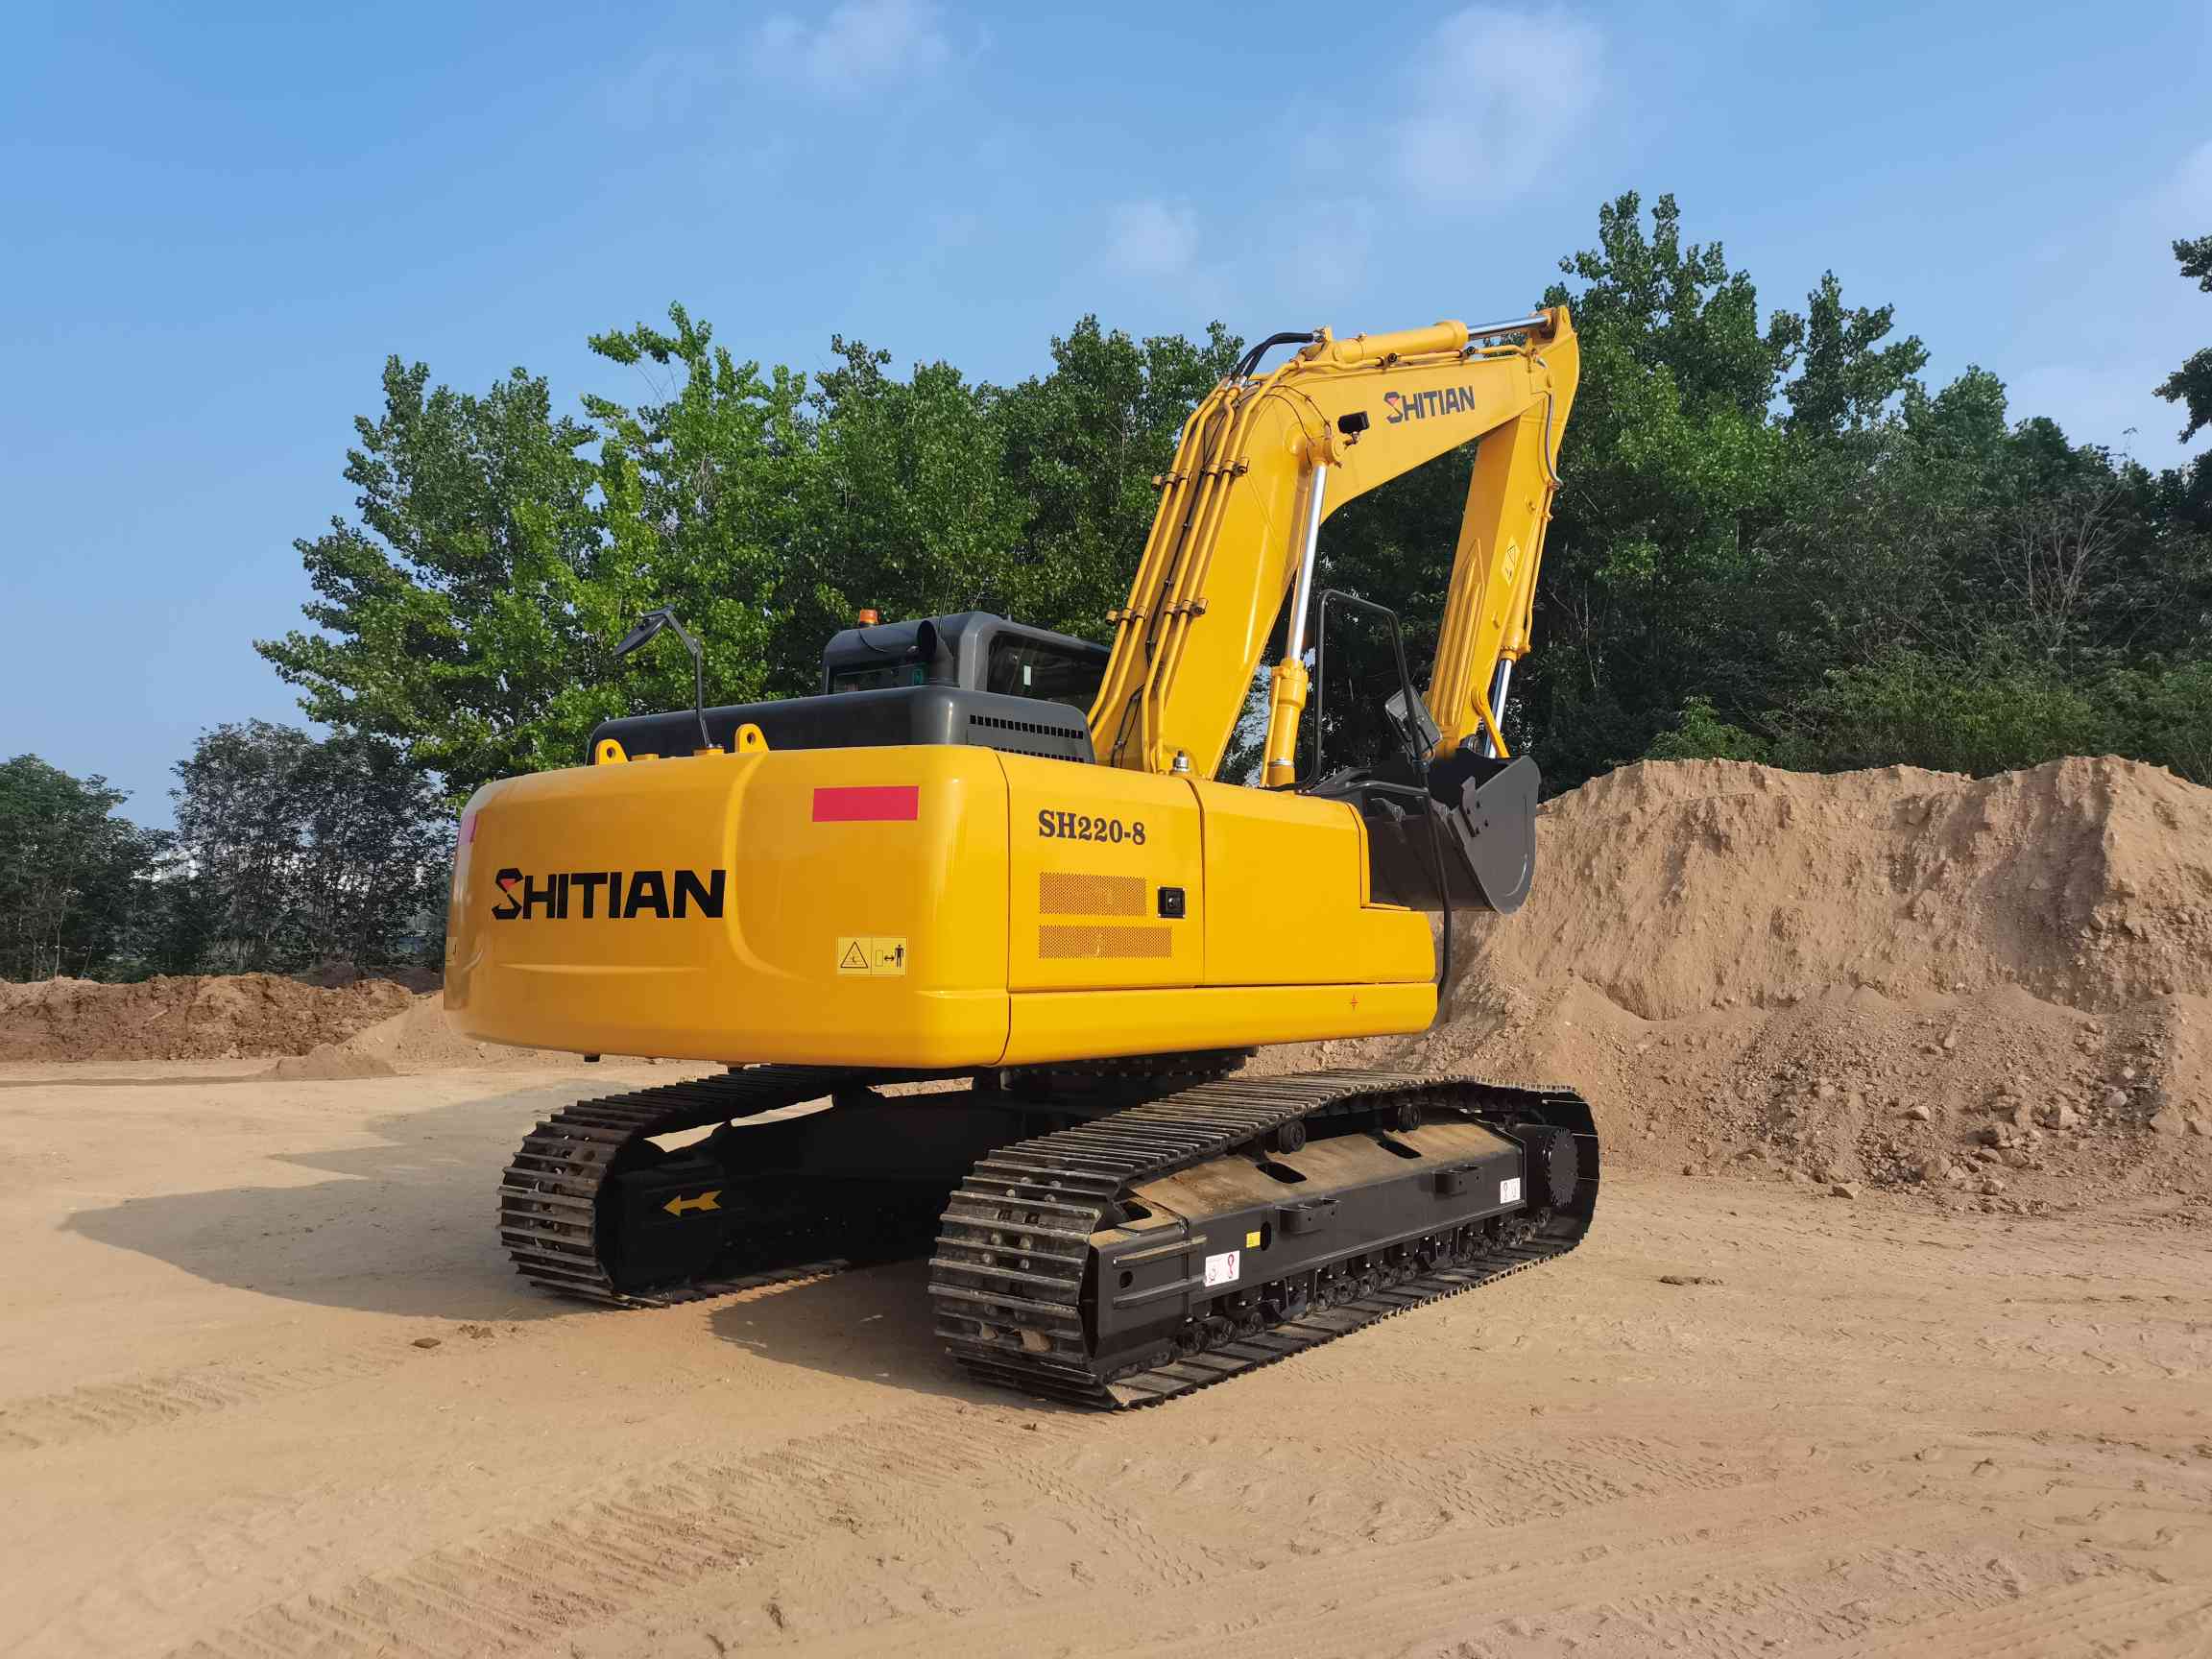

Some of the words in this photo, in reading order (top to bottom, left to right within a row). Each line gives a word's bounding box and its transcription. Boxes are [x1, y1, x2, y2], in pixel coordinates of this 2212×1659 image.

[1383, 385, 1475, 423] SHITIAN
[1038, 809, 1146, 845] SH220-8
[492, 868, 727, 920] SHITIAN
